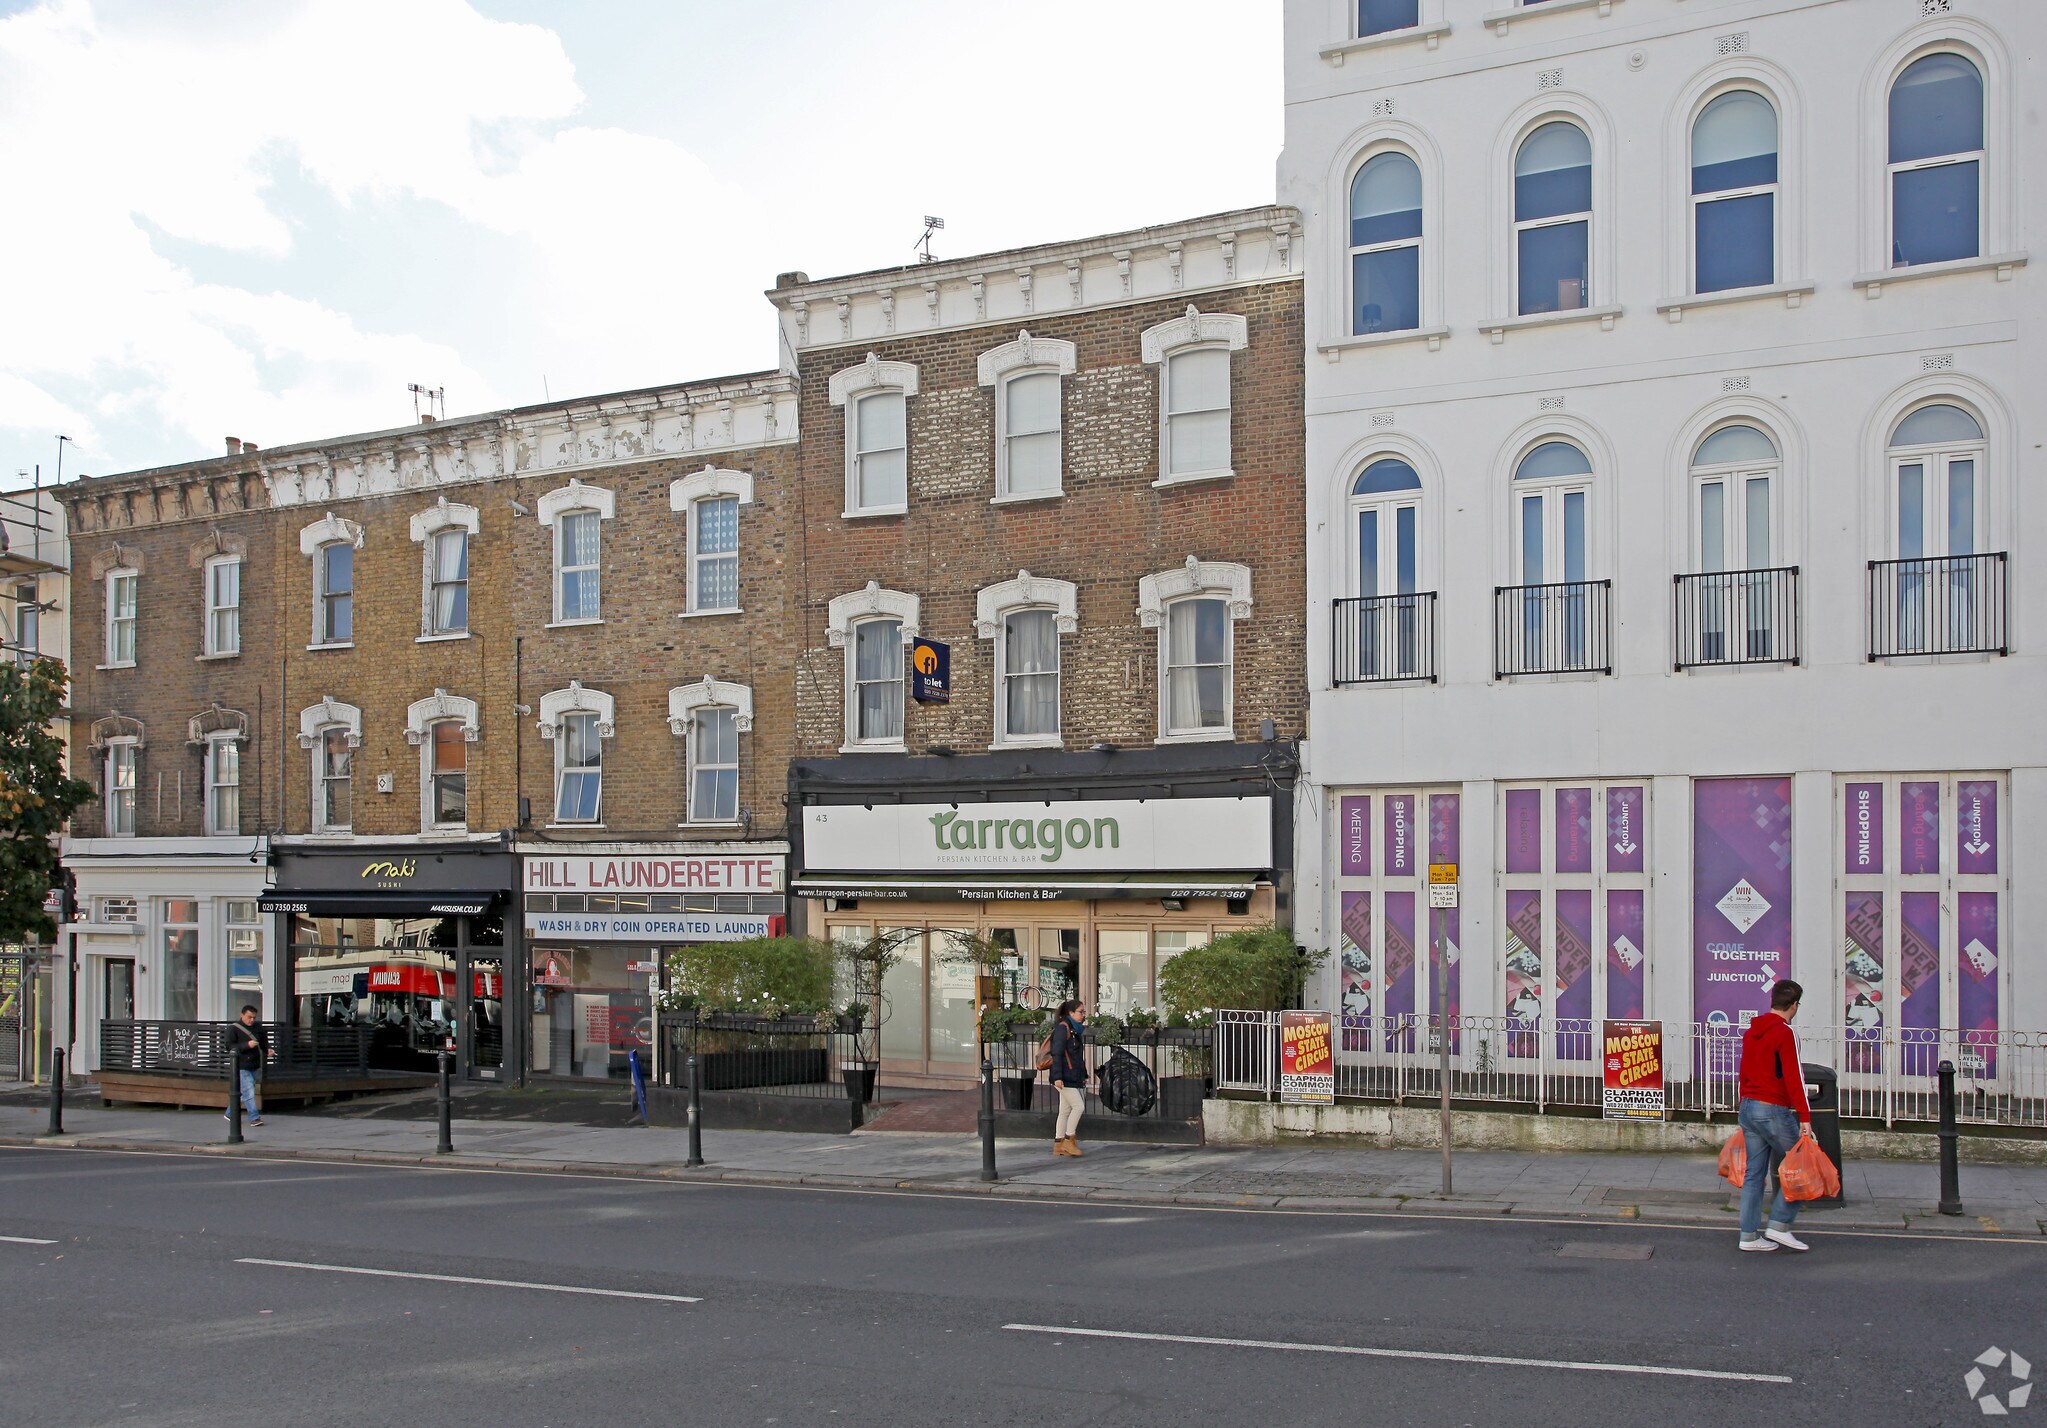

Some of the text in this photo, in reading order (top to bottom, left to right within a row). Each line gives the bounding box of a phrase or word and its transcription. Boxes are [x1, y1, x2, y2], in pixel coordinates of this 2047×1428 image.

[924, 677, 942, 688] to let
[815, 814, 828, 822] 43
[1973, 797, 1981, 846] JUNCTION
[1858, 790, 1870, 865] SHOPPING
[928, 810, 1120, 863] tarragon
[1352, 808, 1362, 863] MEETING
[1396, 801, 1404, 868] SHOPPING
[936, 855, 970, 863] PERSIAN
[528, 860, 772, 888] HILL LAUNDERETTE
[797, 888, 908, 899] www.tarragon-persian-bar.co.uk
[996, 888, 1030, 899] Kitchen
[1033, 890, 1040, 898] &
[292, 904, 308, 912] 2565
[430, 905, 484, 913] MAKISUSHI.CO.UK
[525, 928, 536, 938] 41
[538, 920, 572, 931] WASH
[574, 921, 582, 930] &
[584, 922, 607, 932] DRY
[612, 922, 640, 932] COIN
[644, 922, 710, 933] OPERATED
[1706, 943, 1744, 952] COME
[1712, 950, 1780, 961] TOGETHER
[1707, 973, 1766, 982] JUNCTION
[1284, 1022, 1329, 1043] MOSCOW
[1298, 1036, 1325, 1055] STATE
[1606, 1034, 1659, 1055] MOSCOW
[1295, 1046, 1329, 1072] CIRCUS
[1622, 1047, 1654, 1068] STATE
[1620, 1059, 1659, 1086] CIRCUS
[1605, 1096, 1663, 1104] COMMON
